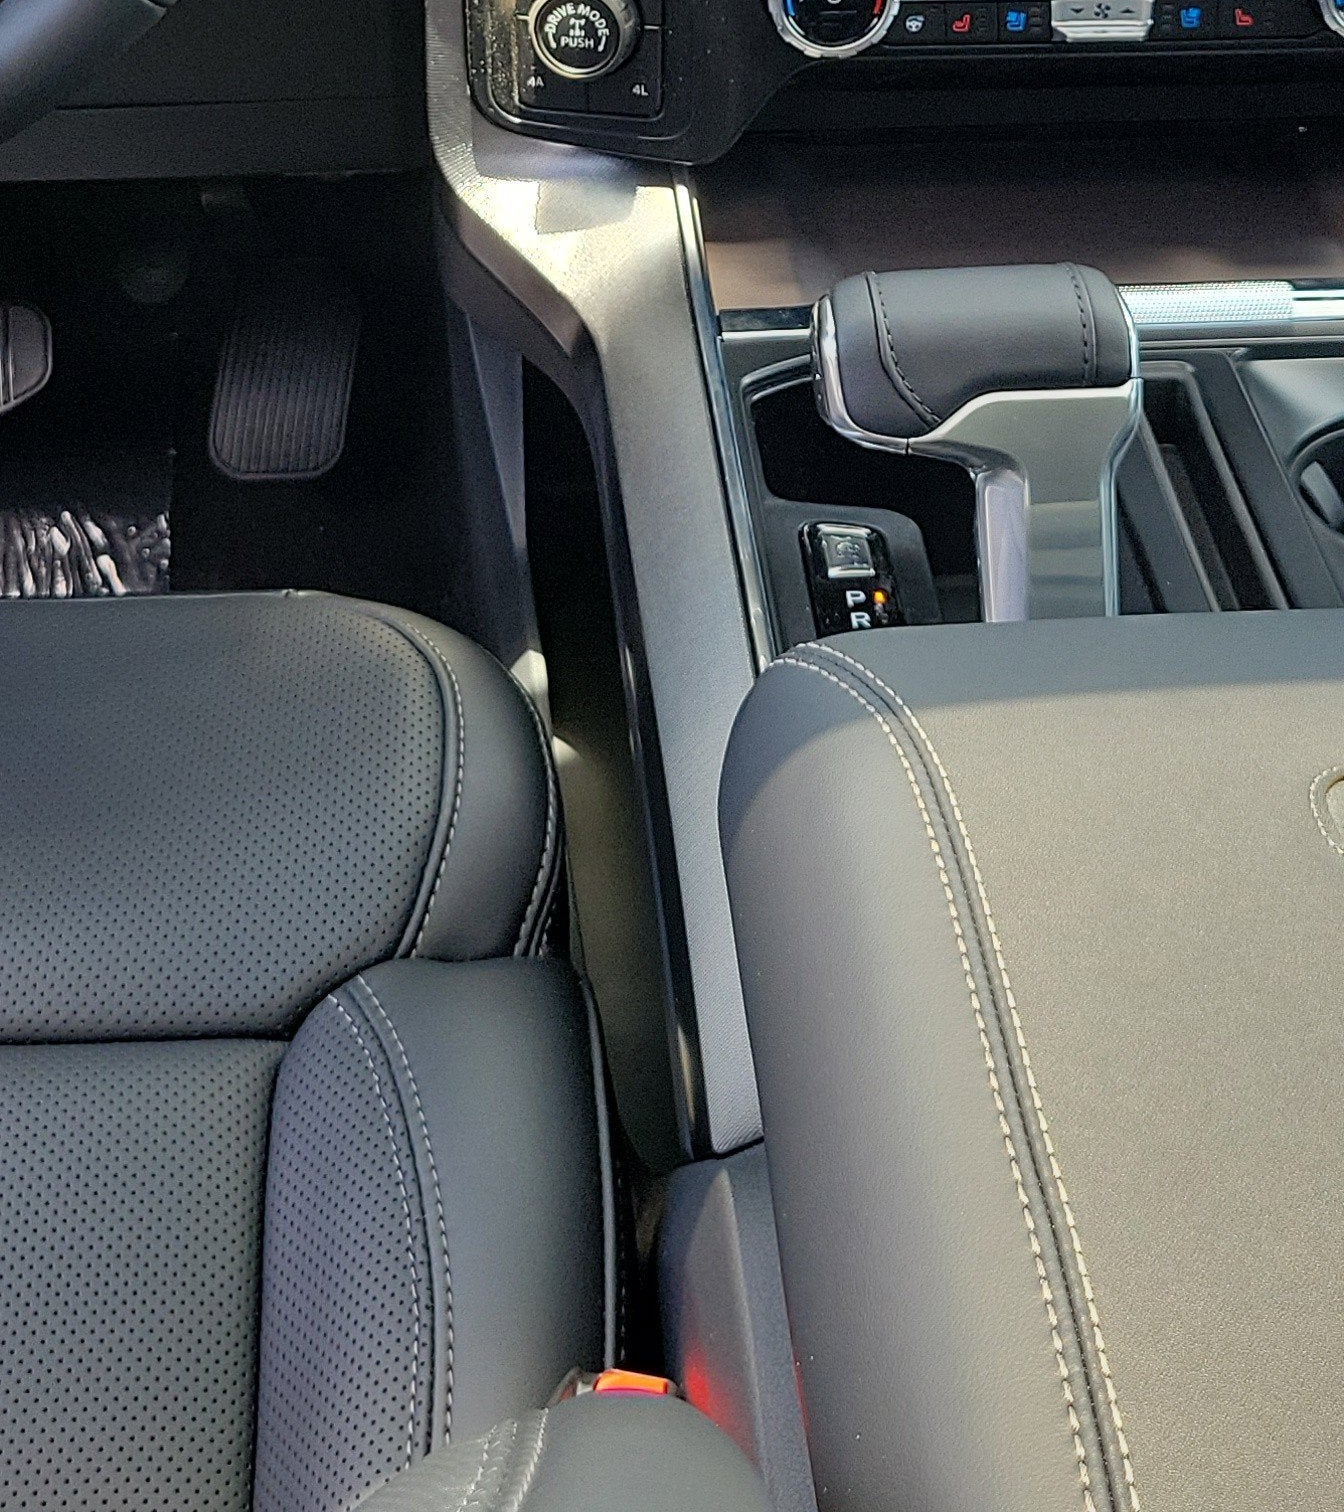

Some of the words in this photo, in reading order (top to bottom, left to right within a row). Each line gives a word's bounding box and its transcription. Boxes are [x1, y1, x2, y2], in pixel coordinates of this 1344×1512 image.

[544, 2, 576, 34] DRIVE
[576, 2, 610, 36] MODE
[560, 35, 595, 48] PUSH
[526, 76, 544, 88] 4A
[632, 84, 649, 96] 4L
[845, 589, 867, 608] P
[850, 611, 871, 629] R
